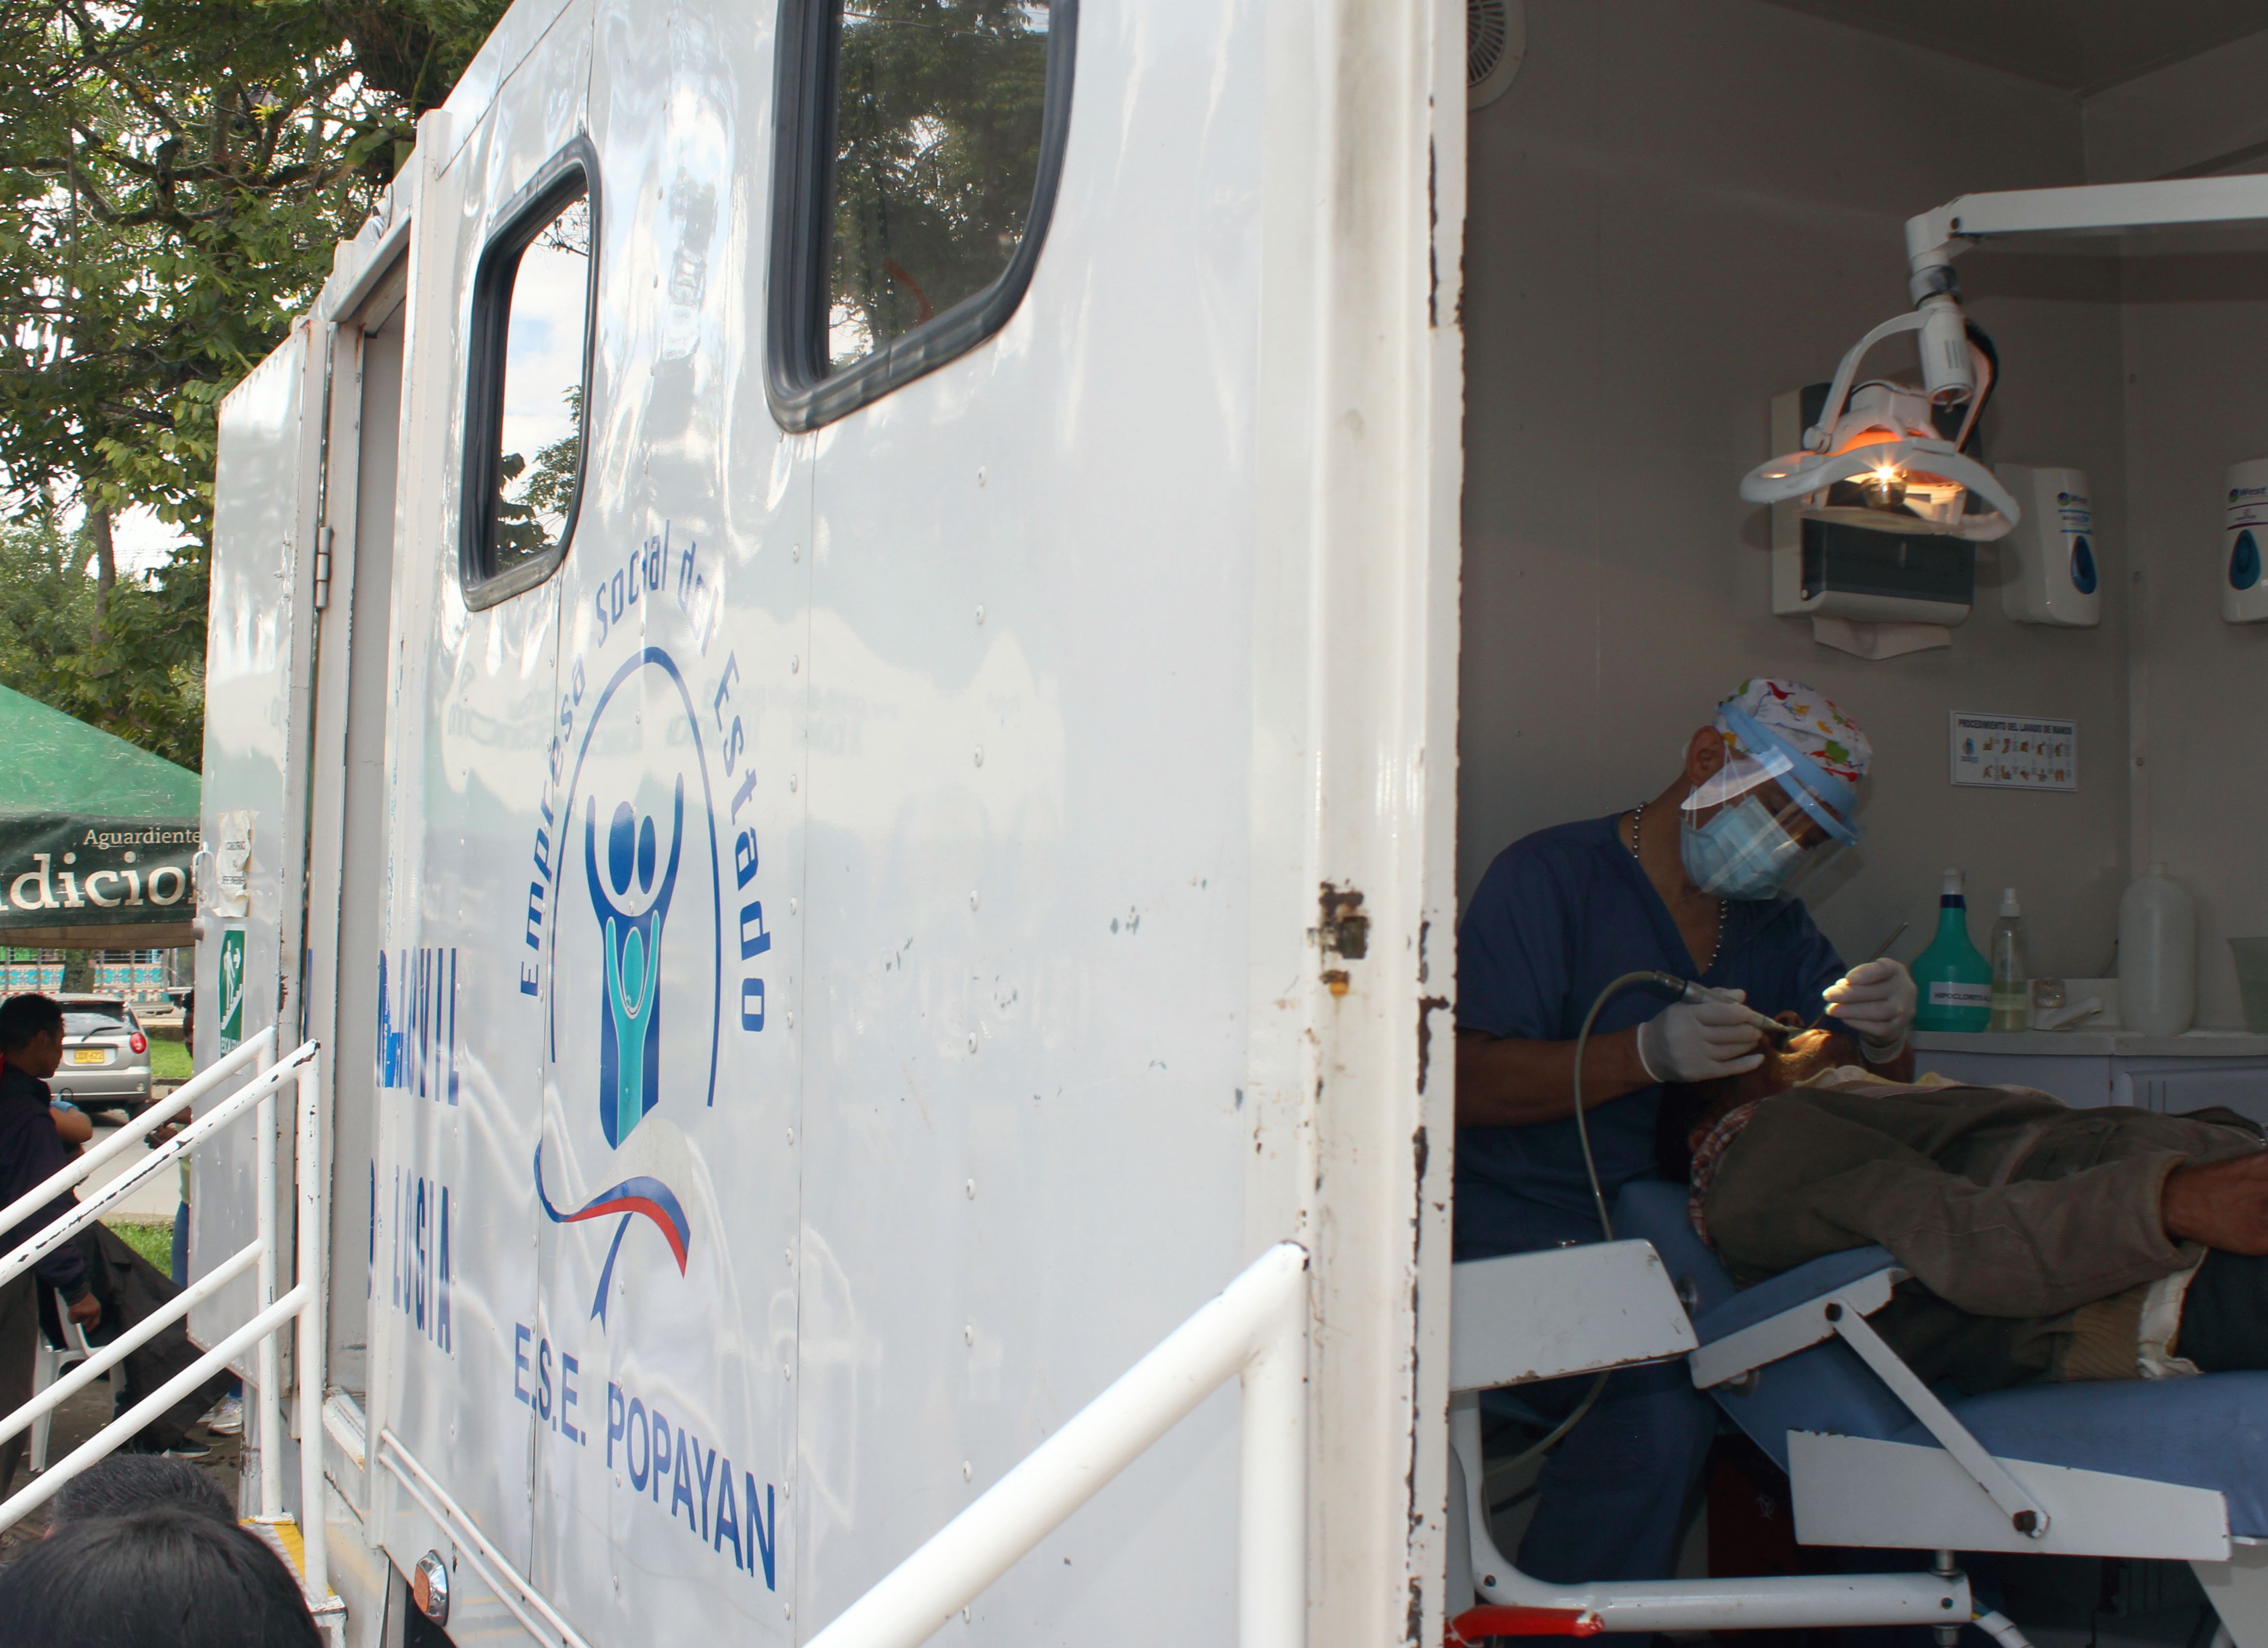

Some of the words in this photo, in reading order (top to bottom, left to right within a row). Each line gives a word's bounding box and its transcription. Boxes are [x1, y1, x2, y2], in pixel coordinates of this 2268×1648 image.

[0, 852, 197, 911] dicio
[83, 828, 200, 849] Aguardiente
[520, 653, 586, 997] Empresa
[714, 649, 771, 1032] Estado
[514, 1322, 586, 1447] E.S.E.
[606, 1380, 775, 1592] POPAYAN
